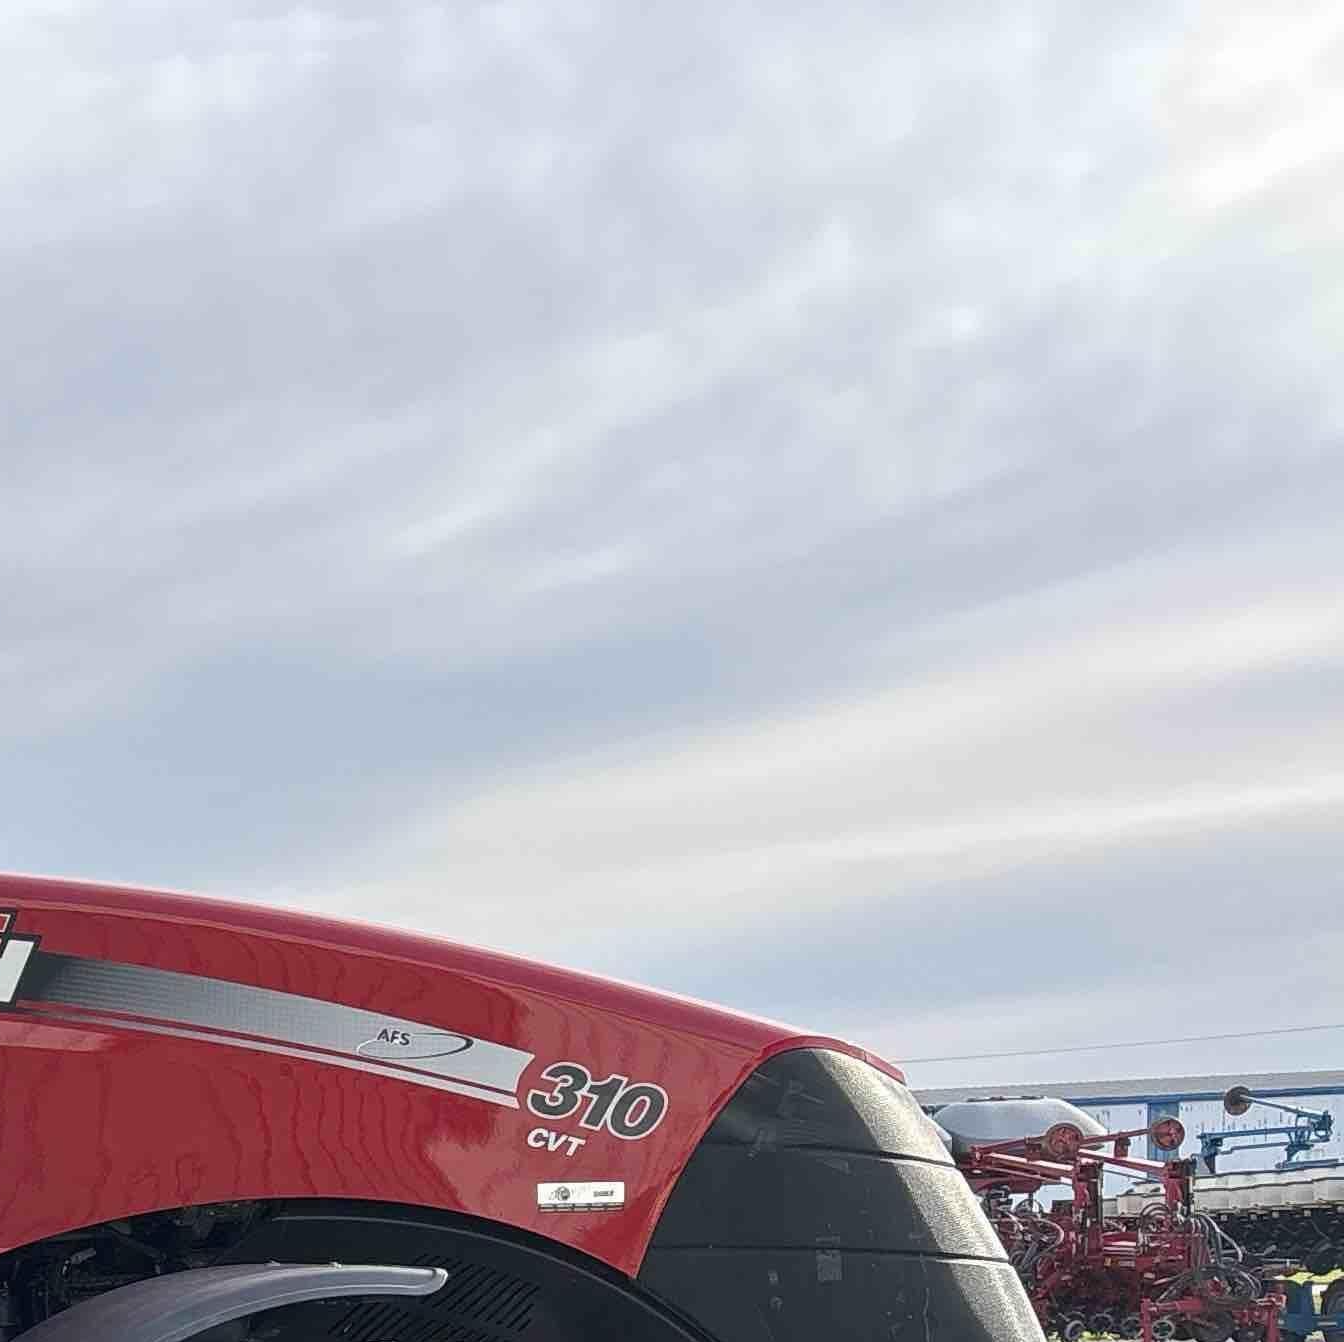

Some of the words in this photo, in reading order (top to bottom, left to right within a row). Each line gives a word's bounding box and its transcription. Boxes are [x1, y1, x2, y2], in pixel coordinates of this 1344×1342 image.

[376, 1028, 411, 1046] AFS
[527, 1062, 668, 1140] 310
[527, 1128, 586, 1156] CVT
